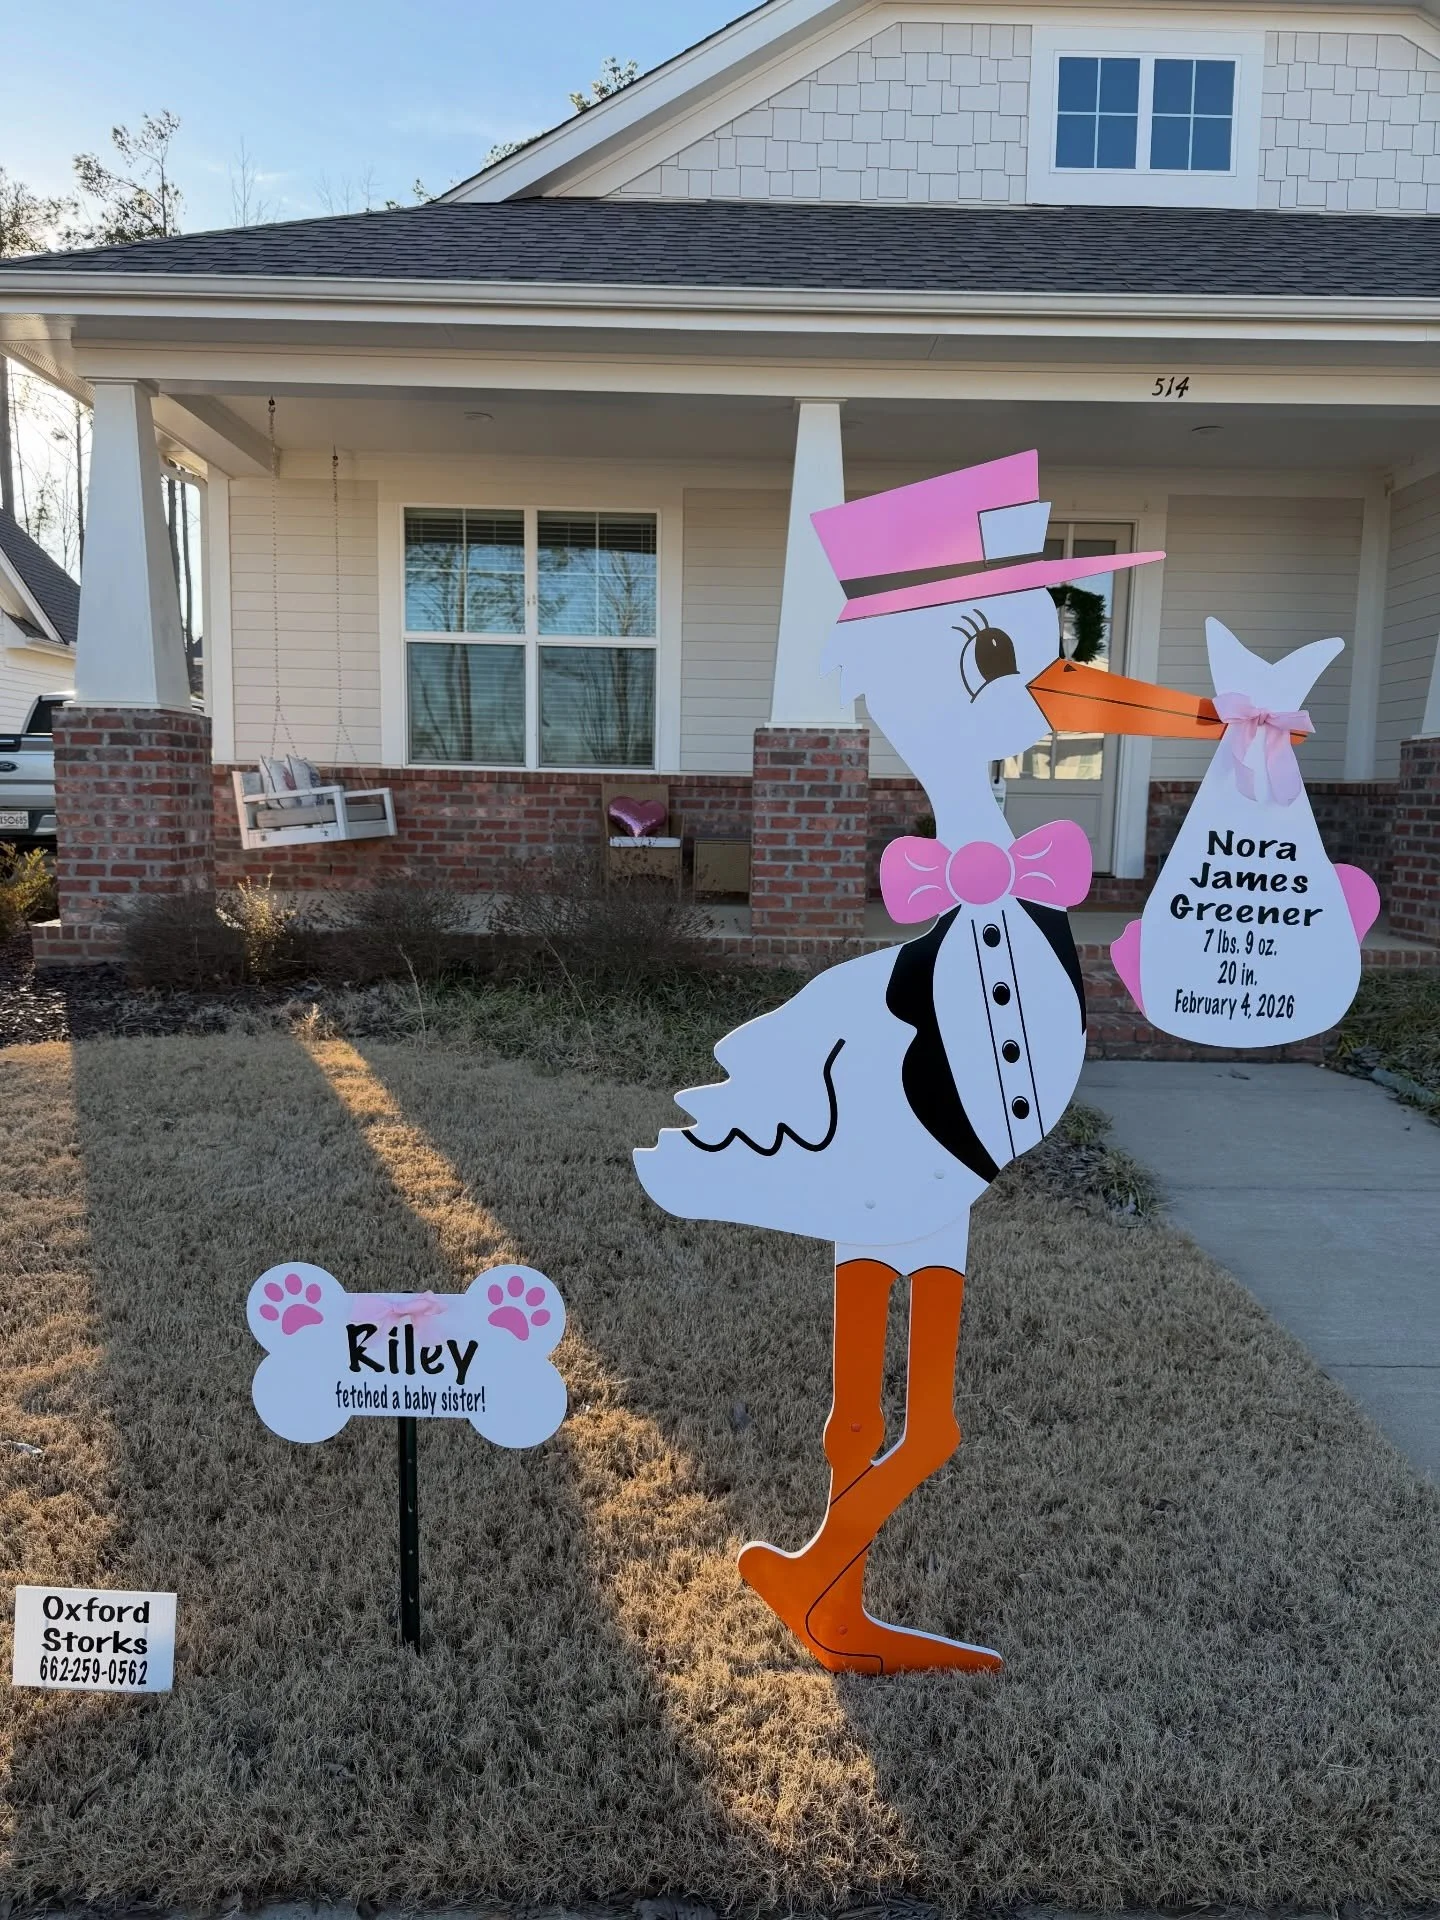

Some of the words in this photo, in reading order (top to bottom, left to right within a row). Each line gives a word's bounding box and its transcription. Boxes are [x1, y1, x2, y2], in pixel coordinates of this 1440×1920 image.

[1151, 376, 1190, 399] 514
[1206, 829, 1297, 862] Nora
[1189, 861, 1309, 894] James
[1169, 893, 1324, 927] Greener
[1203, 928, 1215, 953] 7
[1217, 928, 1240, 955] lbs.
[1244, 930, 1254, 955] 9
[1258, 938, 1277, 956] oz.
[1217, 960, 1237, 986] 20
[1240, 962, 1258, 987] in.
[1174, 988, 1238, 1021] February
[1240, 991, 1252, 1020] 4,
[1255, 993, 1296, 1019] 2026
[345, 1323, 479, 1386] Riley
[335, 1380, 388, 1409] fetched
[392, 1390, 401, 1410] a
[404, 1384, 437, 1416] baby
[441, 1385, 486, 1413] sister!
[42, 1595, 150, 1624] Oxford
[41, 1627, 149, 1655] Storks
[39, 1655, 148, 1686] 662-259-0562
